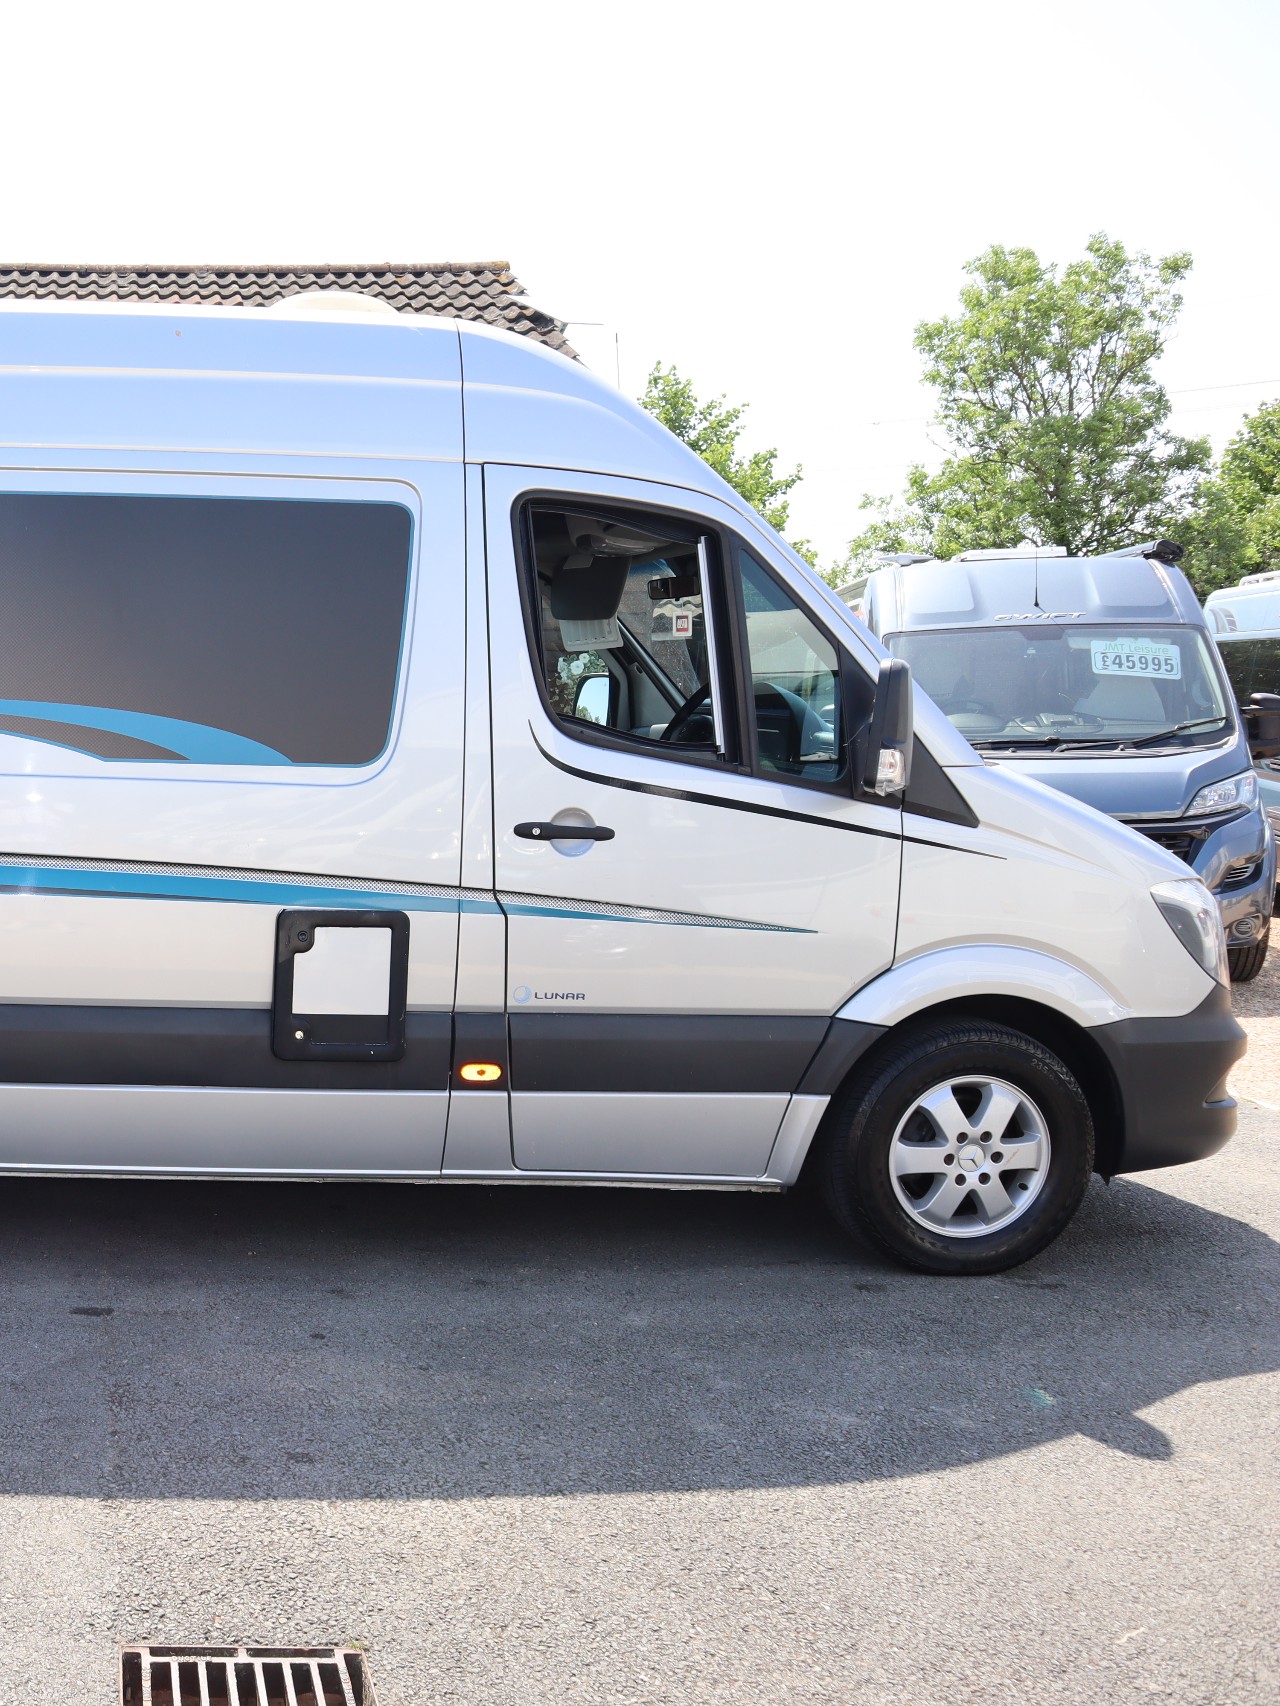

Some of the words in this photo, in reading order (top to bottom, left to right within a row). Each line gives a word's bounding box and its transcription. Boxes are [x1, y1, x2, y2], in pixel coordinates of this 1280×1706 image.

[994, 611, 1087, 621] SWIFT
[1102, 642, 1125, 652] JMT
[1128, 644, 1169, 655] Leisure
[1101, 654, 1175, 673] £45995
[534, 991, 586, 1001] LUNAR
